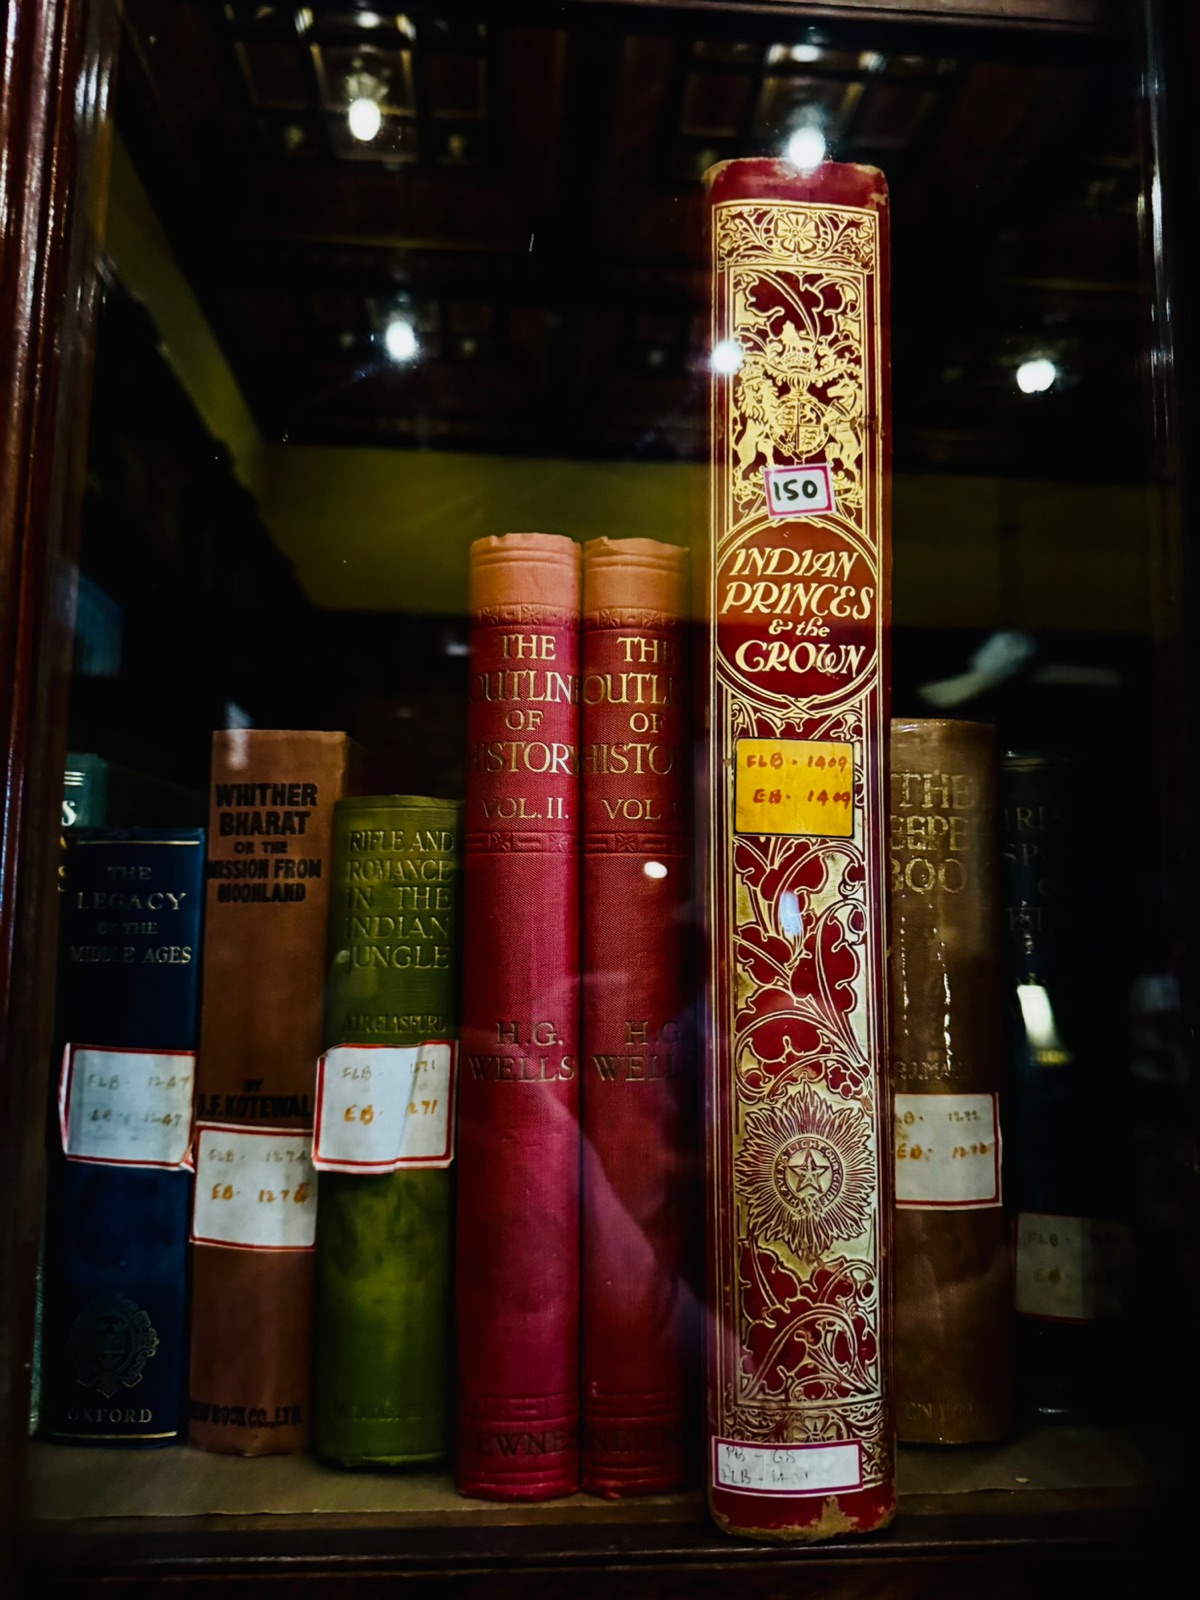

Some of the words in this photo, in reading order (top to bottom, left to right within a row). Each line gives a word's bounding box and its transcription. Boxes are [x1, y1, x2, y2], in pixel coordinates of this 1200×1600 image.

[773, 479, 818, 501] 150
[729, 547, 859, 582] INDIAN
[719, 581, 874, 620] PRINCES
[768, 618, 793, 635] &
[795, 616, 831, 637] the
[503, 634, 557, 660] THE
[735, 639, 866, 678] CROWN
[505, 709, 544, 731] OF
[629, 713, 664, 733] OF
[216, 783, 317, 806] WHITHER
[891, 773, 975, 809] THE
[482, 798, 542, 819] VOL.
[547, 797, 569, 819] II.
[220, 811, 311, 836] BHARAT
[235, 842, 254, 854] OR
[261, 842, 287, 853] THE
[349, 830, 404, 852] RIFLE
[410, 831, 455, 852] AND
[107, 865, 152, 880] THE
[274, 859, 321, 878] FROM
[346, 858, 451, 882] ROMANCE
[76, 892, 187, 910] LEGACY
[218, 883, 305, 902] MOONLAND
[346, 886, 373, 910] IN
[393, 886, 451, 910] THE
[122, 922, 158, 934] THE
[345, 916, 449, 939] INDIAN
[70, 946, 135, 963] MIDDLE
[142, 946, 192, 963] AGES
[496, 1021, 564, 1047] H.G.
[467, 1055, 575, 1082] WELLS
[244, 1079, 264, 1091] BY
[788, 1139, 822, 1154] LIGHT
[68, 1408, 153, 1423] OXFORD
[213, 1403, 247, 1427] BOOK
